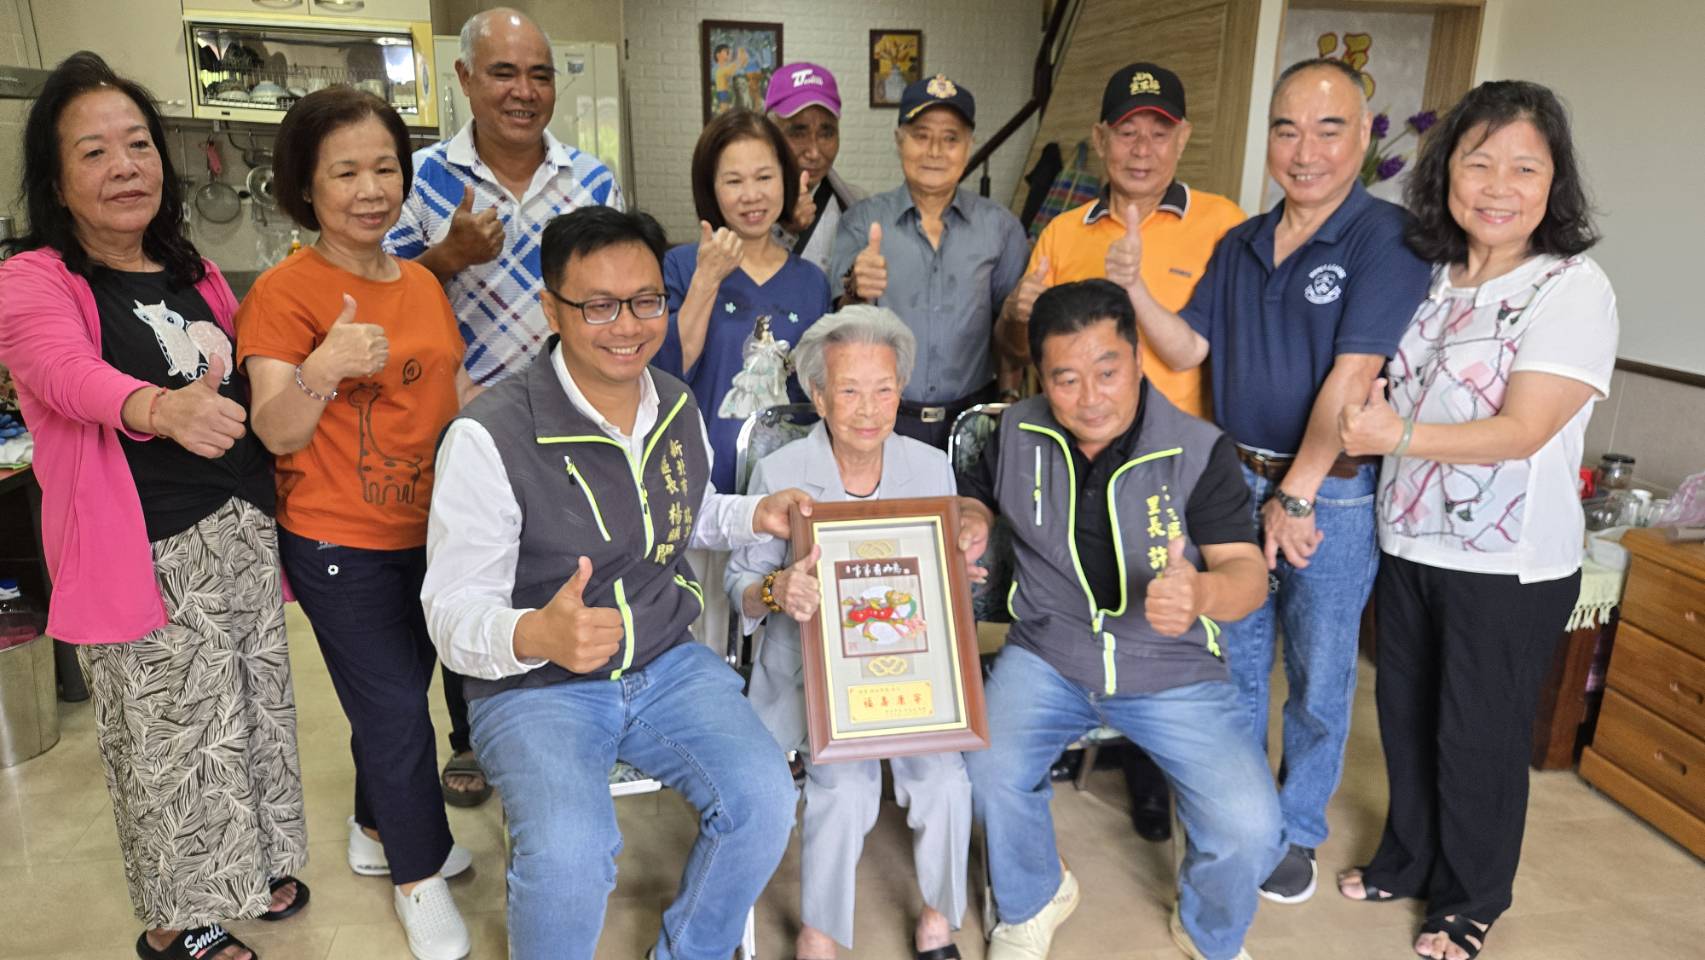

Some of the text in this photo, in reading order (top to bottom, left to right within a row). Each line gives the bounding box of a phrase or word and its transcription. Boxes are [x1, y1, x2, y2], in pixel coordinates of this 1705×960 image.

[669, 439, 689, 496] 新北市
[1146, 495, 1167, 538] 里長
